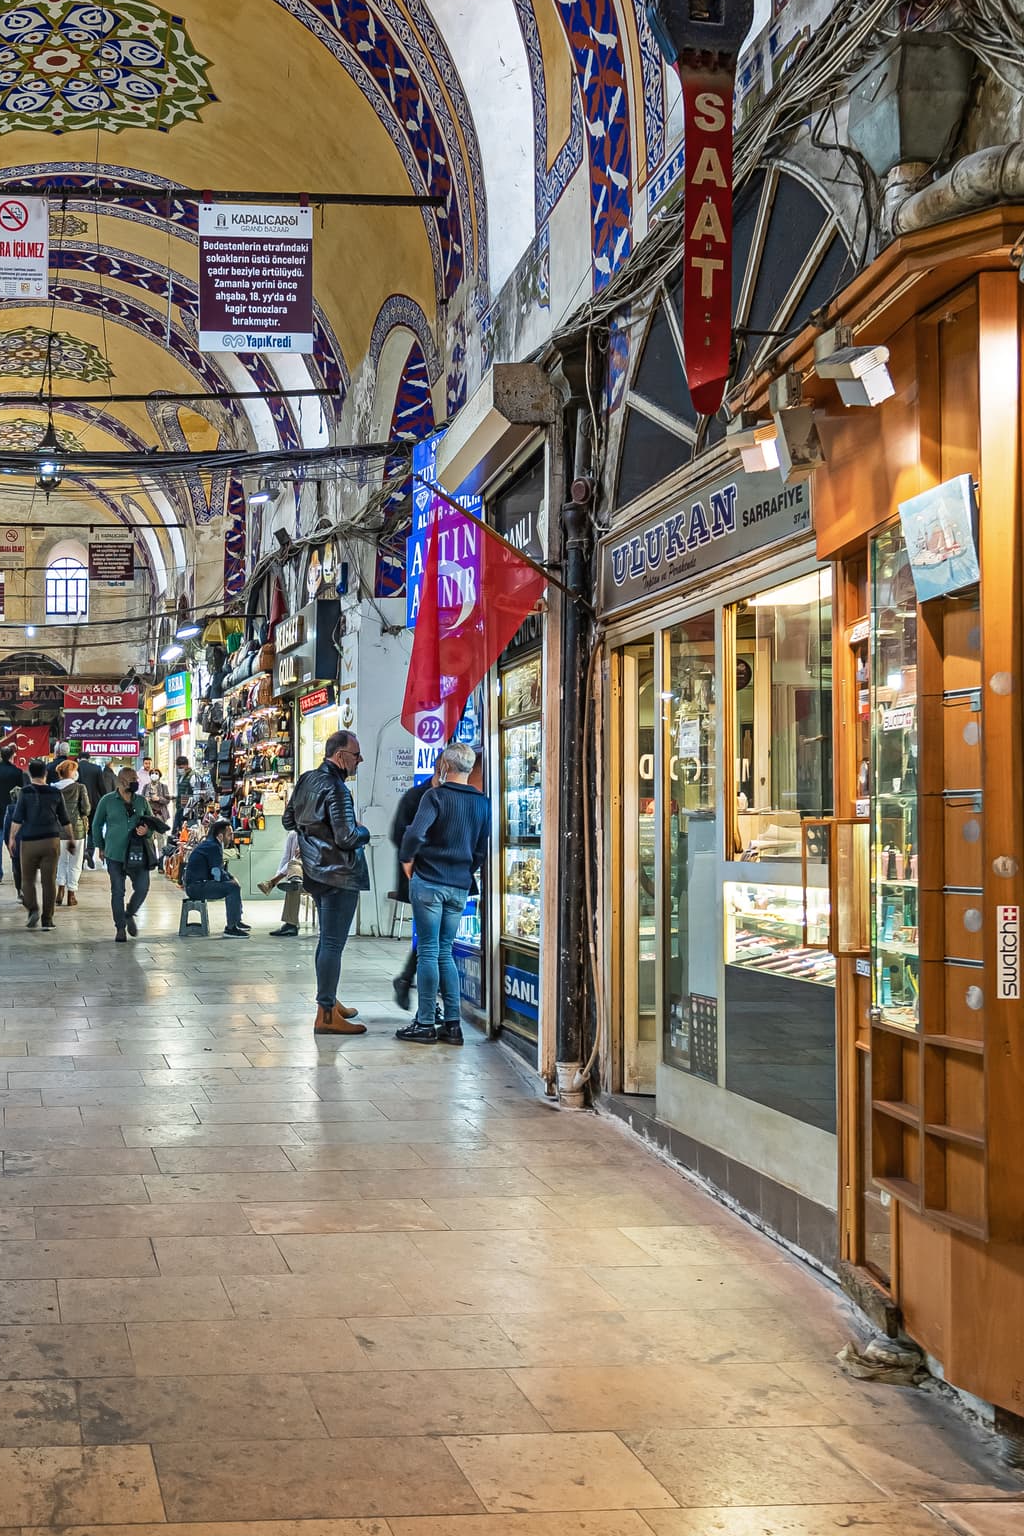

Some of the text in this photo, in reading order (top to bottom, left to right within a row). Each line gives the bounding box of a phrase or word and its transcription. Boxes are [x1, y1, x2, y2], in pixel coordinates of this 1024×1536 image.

[690, 93, 728, 298] SAAT
[12, 240, 44, 260] İÇİLMEZ
[203, 241, 308, 252] Bedestenlerin etrafındaki
[206, 254, 306, 265] sokakların üstü önceleri
[208, 266, 304, 278] çadır beziyle örtülüydü.
[214, 278, 298, 290] Zamanla yerini önce
[215, 292, 297, 304] ahşaba, 18. yy'da da
[225, 304, 288, 314] kagir tonozlara
[232, 316, 280, 328] bırakmıştır.
[246, 334, 292, 349] YapıKredi
[742, 484, 803, 527] SARRAFİYE
[611, 482, 737, 586] ULUKAN
[80, 696, 122, 706] ALINIR
[69, 716, 133, 734] ŞAHİN
[422, 720, 440, 739] 22
[84, 744, 108, 752] ALTIN
[110, 744, 136, 753] ALINIR
[1000, 921, 1018, 996] swatch
